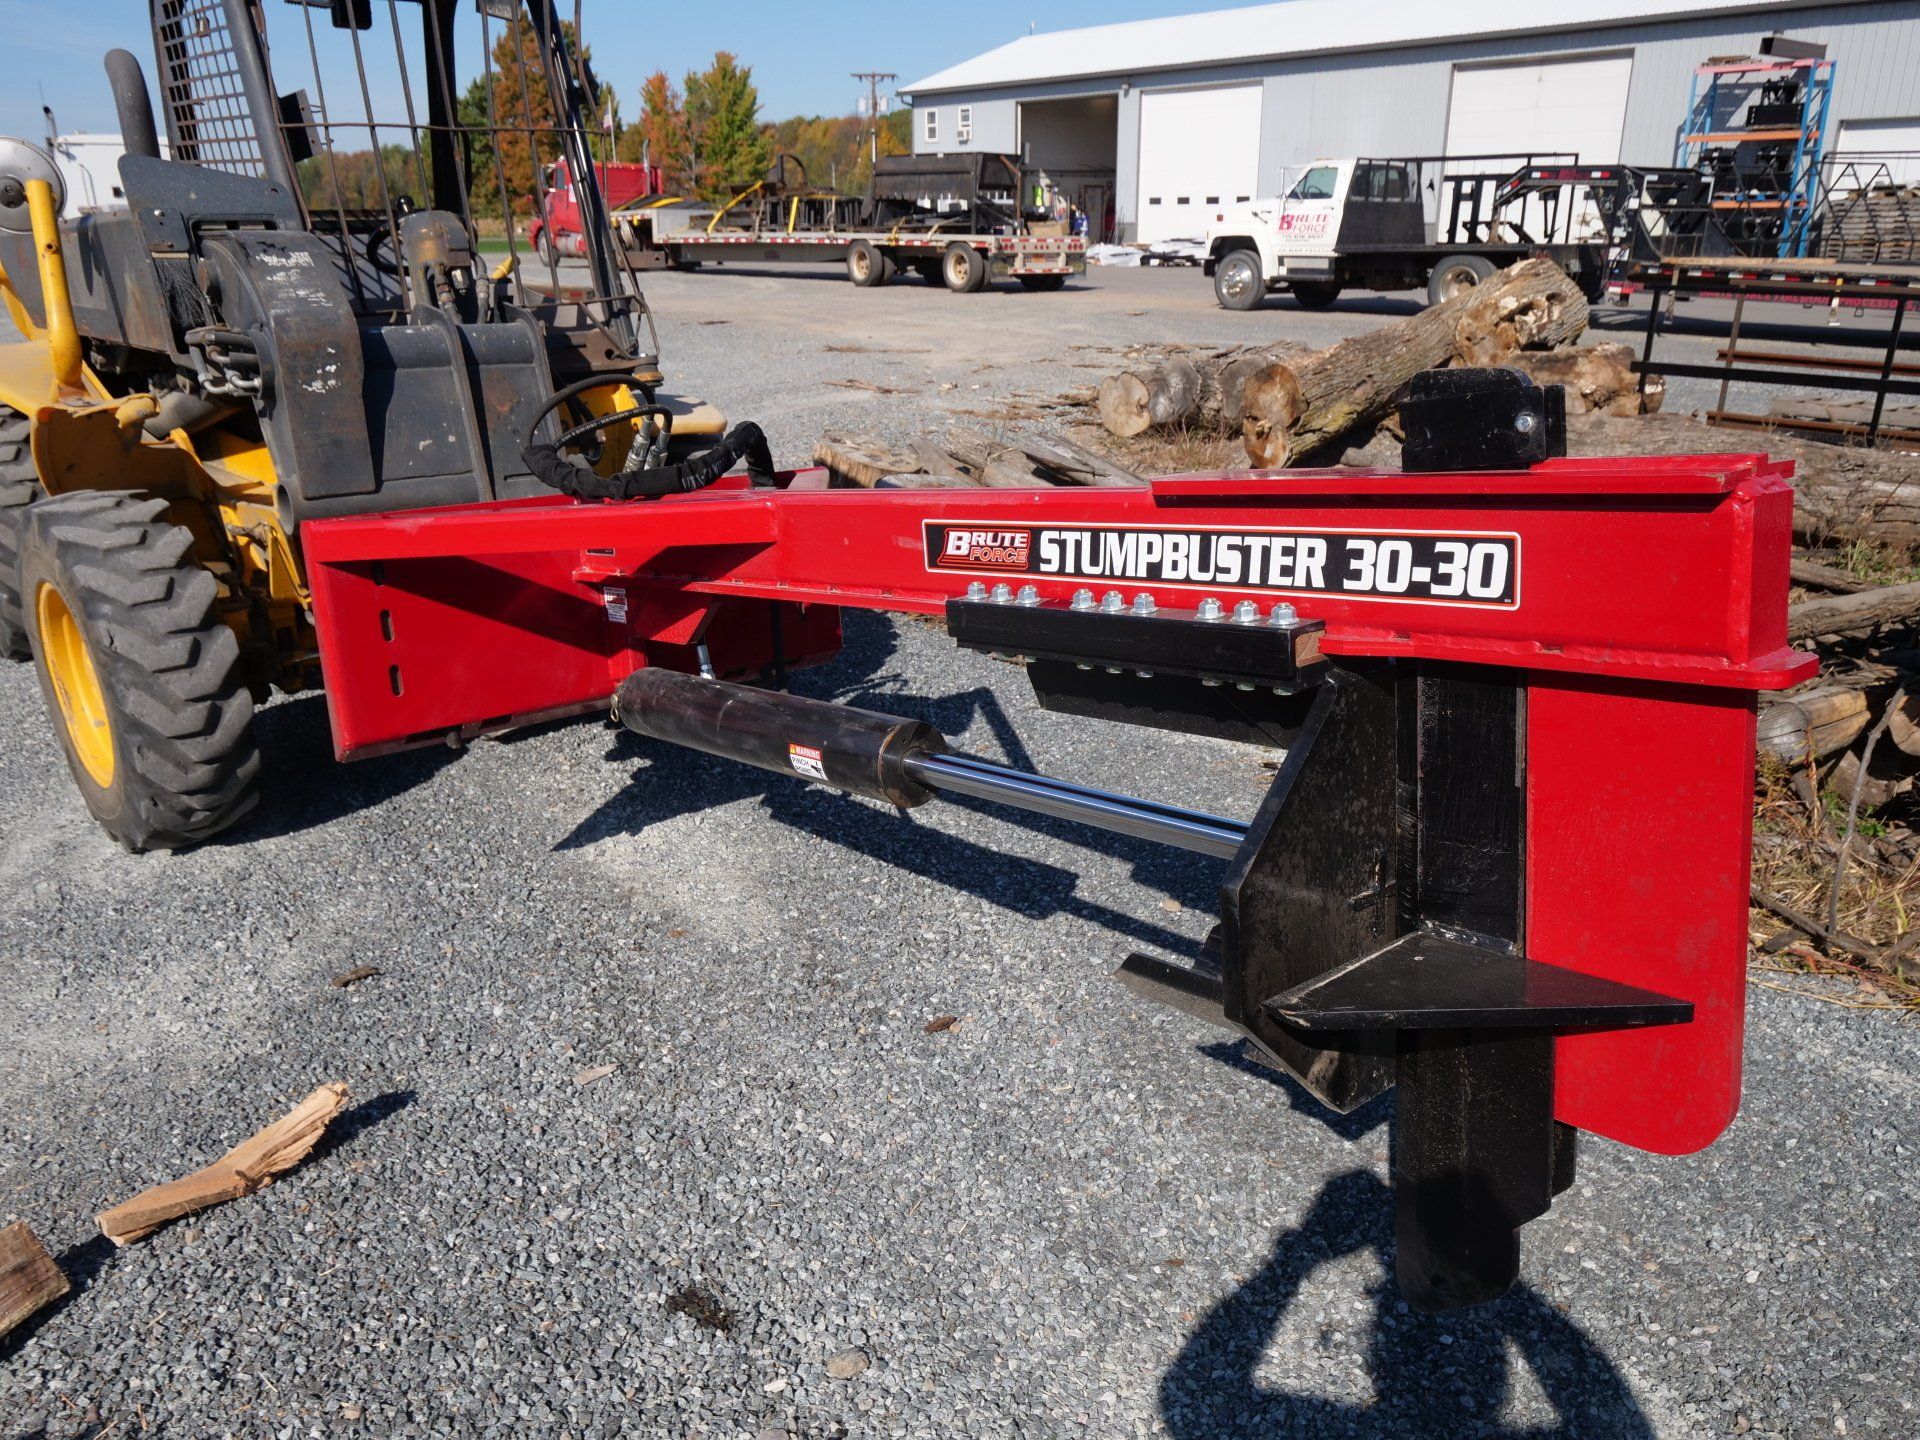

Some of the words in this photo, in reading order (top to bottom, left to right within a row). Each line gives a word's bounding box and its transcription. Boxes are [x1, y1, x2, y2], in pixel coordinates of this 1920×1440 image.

[1279, 214, 1329, 231] BRUTE
[1293, 224, 1328, 233] FORCE
[1839, 297, 1914, 311] PROCESSOS
[945, 531, 1029, 556] BRUTE
[969, 547, 1027, 563] FORCE
[1039, 530, 1328, 589] STUMPBUSTER
[1343, 539, 1509, 598] 30-30
[796, 745, 820, 760] WARNING
